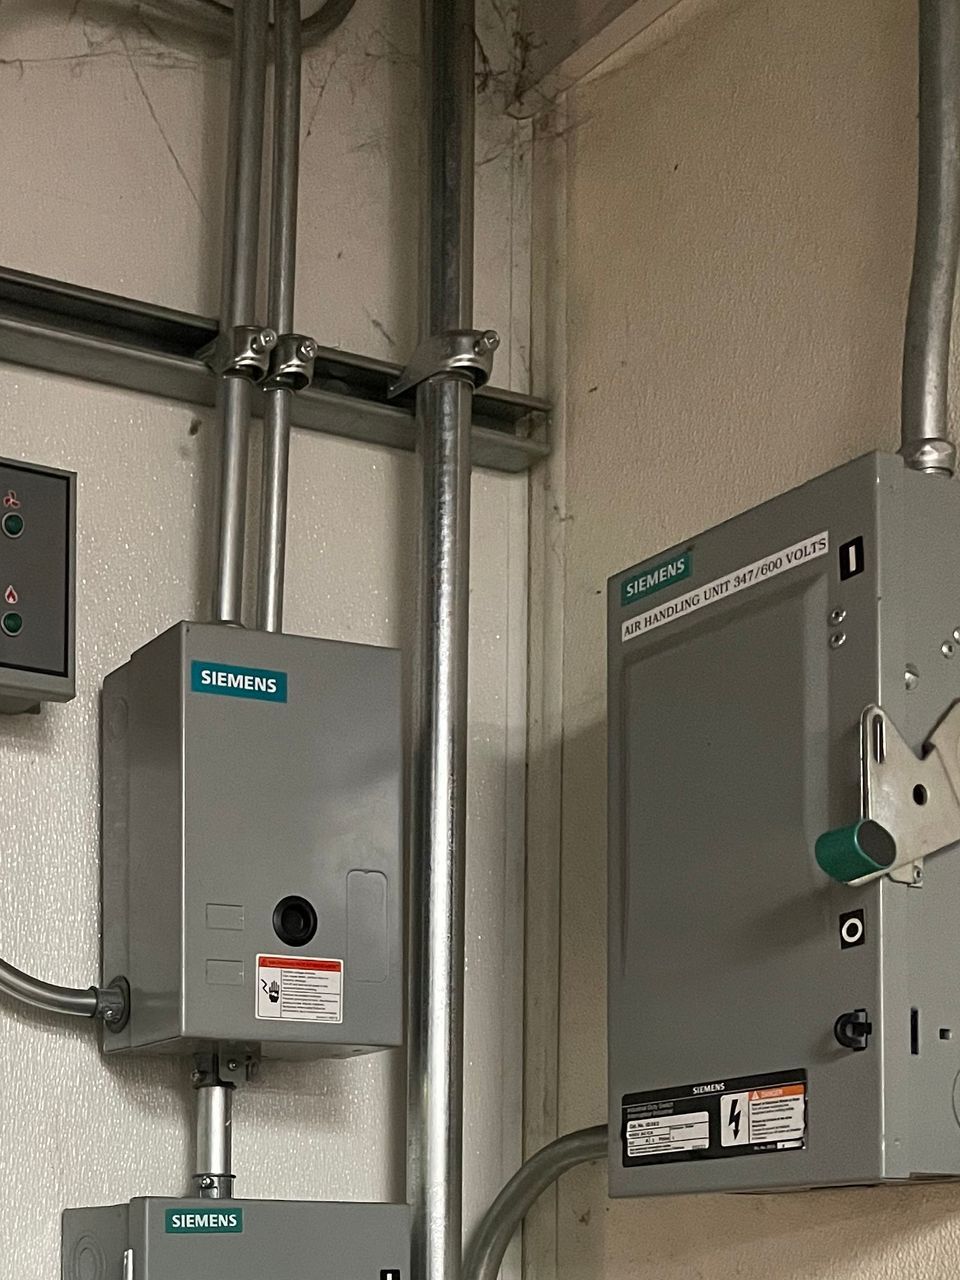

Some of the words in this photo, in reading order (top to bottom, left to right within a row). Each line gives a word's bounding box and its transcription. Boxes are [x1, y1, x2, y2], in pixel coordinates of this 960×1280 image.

[624, 620, 642, 638] AIR
[644, 595, 701, 628] HANDLING
[704, 580, 732, 601] UNIT
[734, 557, 782, 590] 347/600
[786, 538, 827, 565] VOLTS
[626, 558, 685, 598] SIEMENS
[201, 670, 277, 694] SIEMENS
[692, 1082, 726, 1094] SIEMENS
[172, 1214, 237, 1228] SIEMENS
